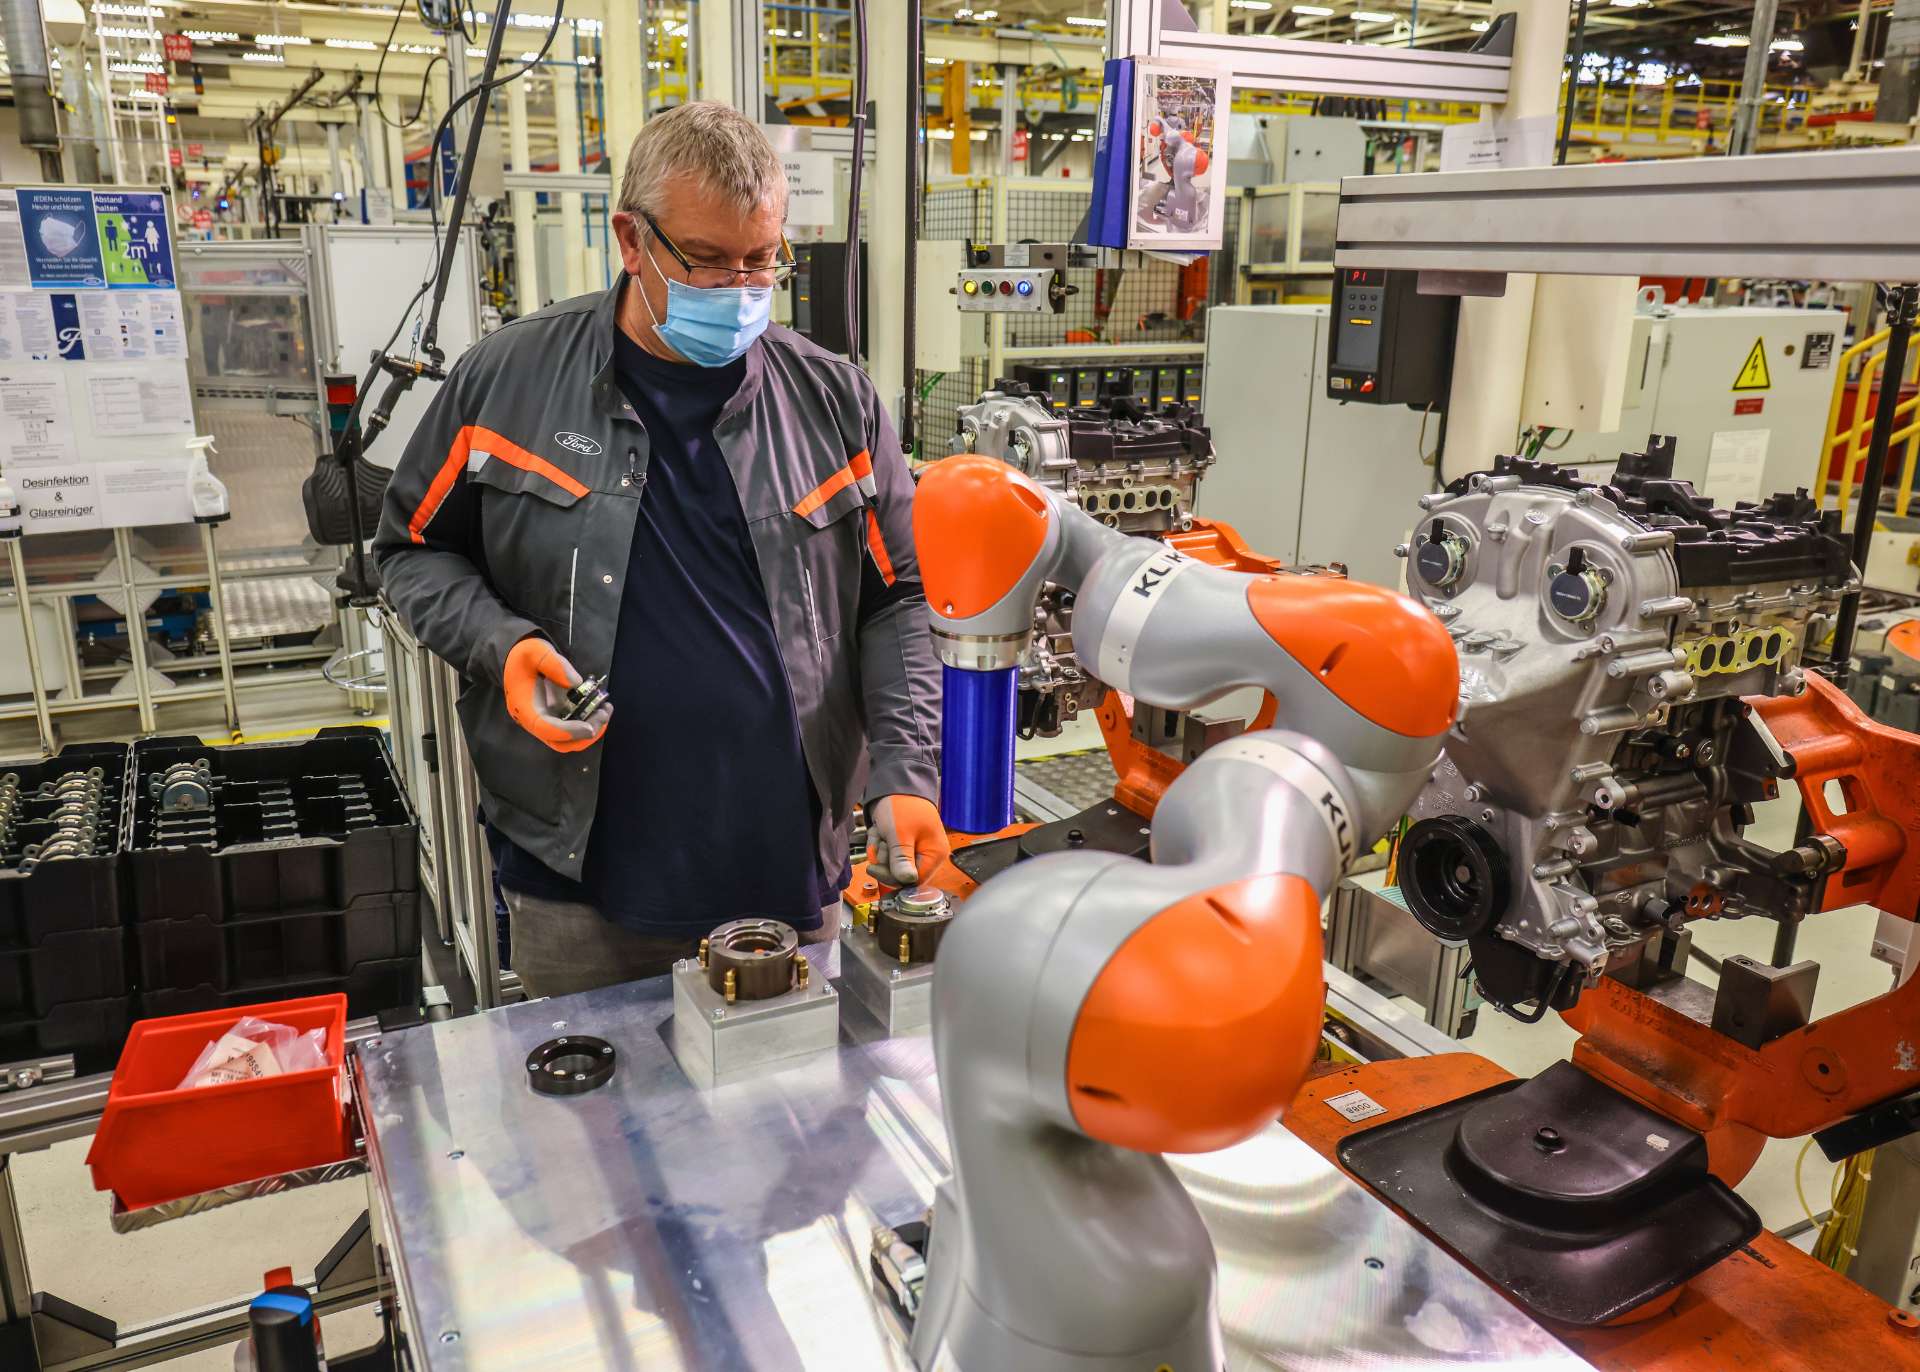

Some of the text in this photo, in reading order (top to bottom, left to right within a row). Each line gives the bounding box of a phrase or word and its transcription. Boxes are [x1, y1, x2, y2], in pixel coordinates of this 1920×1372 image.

[94, 195, 123, 204] Abstand
[562, 434, 594, 453] Ford
[22, 474, 89, 489] Desinfektion
[55, 491, 63, 502] &
[29, 504, 95, 519] Glasreiniger
